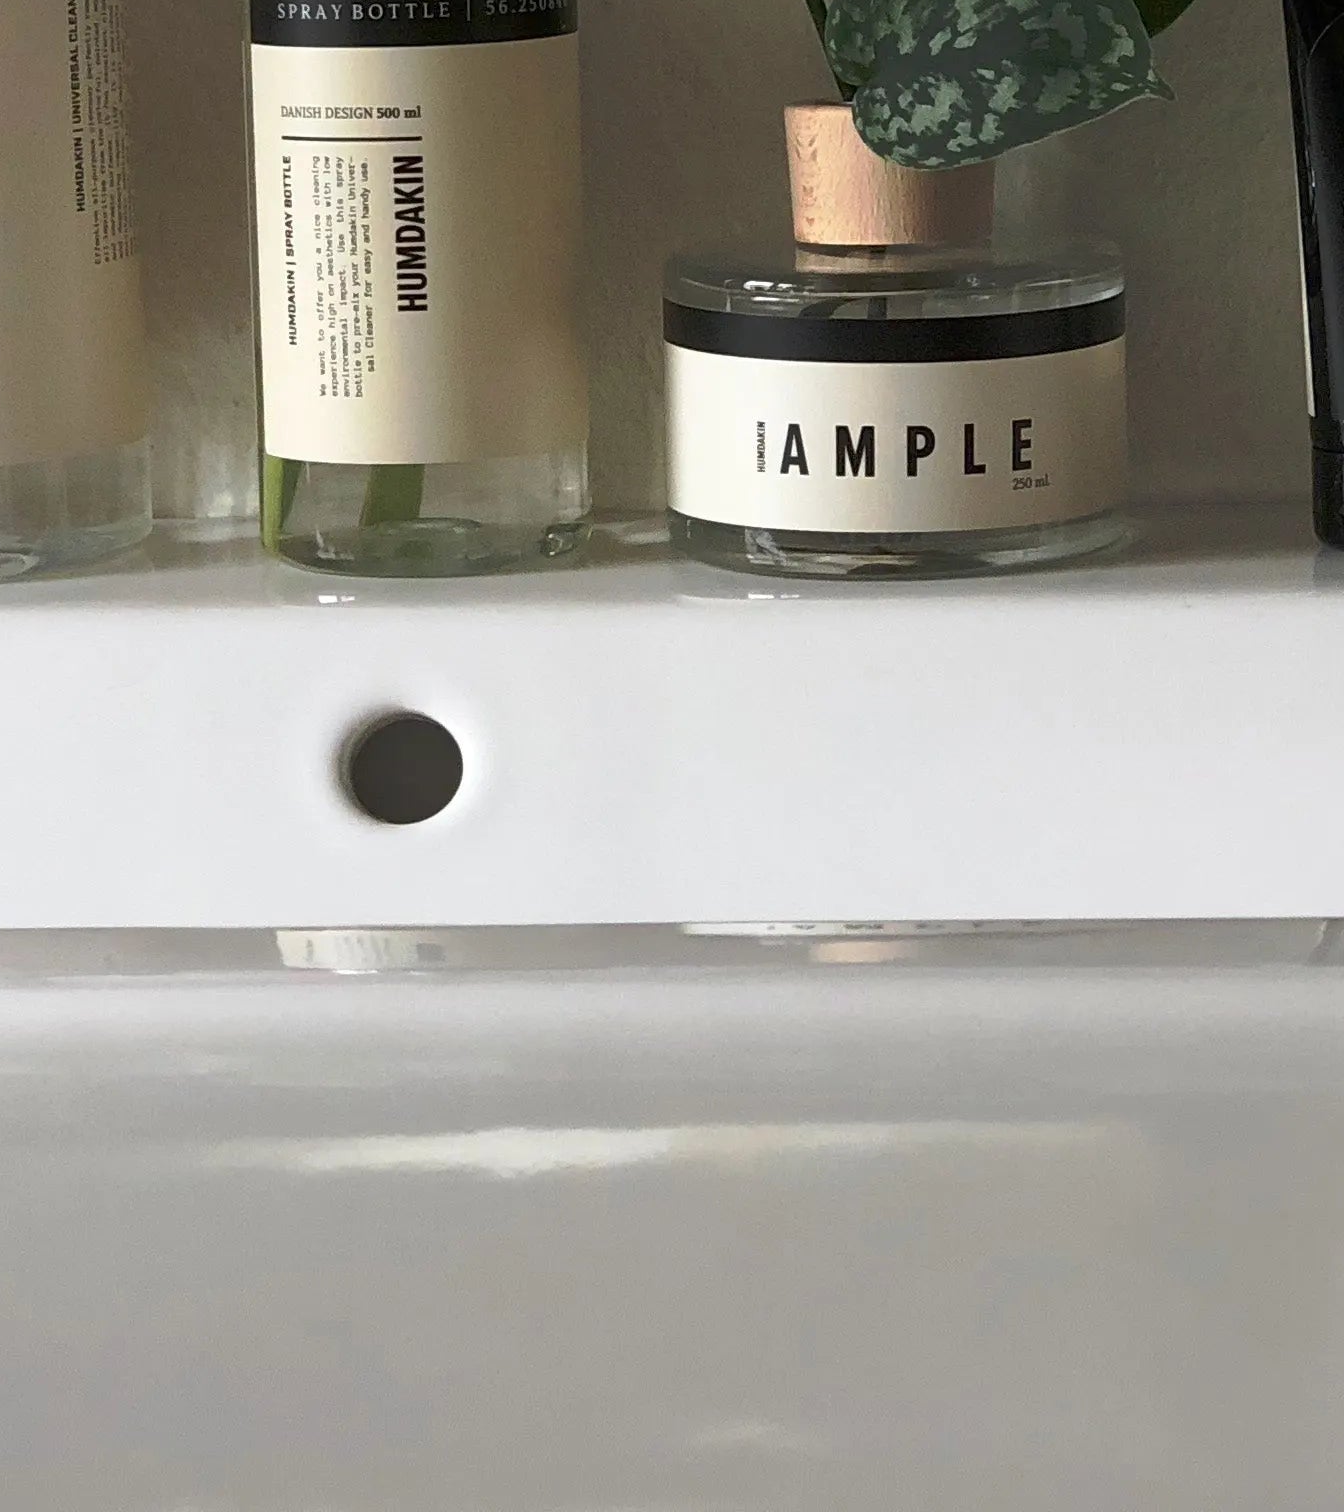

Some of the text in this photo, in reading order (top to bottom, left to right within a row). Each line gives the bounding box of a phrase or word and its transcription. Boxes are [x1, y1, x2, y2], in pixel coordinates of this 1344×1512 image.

[277, 3, 342, 21] SPRAY
[352, 2, 450, 20] BOTTLE
[69, 44, 81, 124] UNIVERSAL
[281, 105, 421, 119] DANISH DESIGN 500 ml
[73, 136, 85, 211] HUMDAKIN
[310, 155, 322, 205] cleaning
[322, 155, 330, 173] low
[346, 156, 356, 200] Univer-
[323, 182, 331, 207] with
[313, 214, 321, 239] nice
[324, 214, 334, 276] aesthetics
[347, 205, 358, 256] Humdakin
[393, 156, 428, 312] HUMDAKIN
[281, 155, 297, 345] HUMDAKIN SPRAY BOTTLE
[316, 262, 324, 281] you
[359, 158, 375, 372] sal Cleaner for easy and handy use.
[351, 262, 360, 286] your
[315, 290, 324, 320] offer
[327, 302, 337, 328] high
[350, 292, 362, 336] pre-mix
[318, 350, 326, 375] want
[328, 334, 339, 396] experience
[352, 359, 363, 397] bottle
[757, 421, 765, 472] HUMDAKIN
[780, 418, 1032, 477] AMPLE
[1012, 475, 1050, 490] 250 ml
